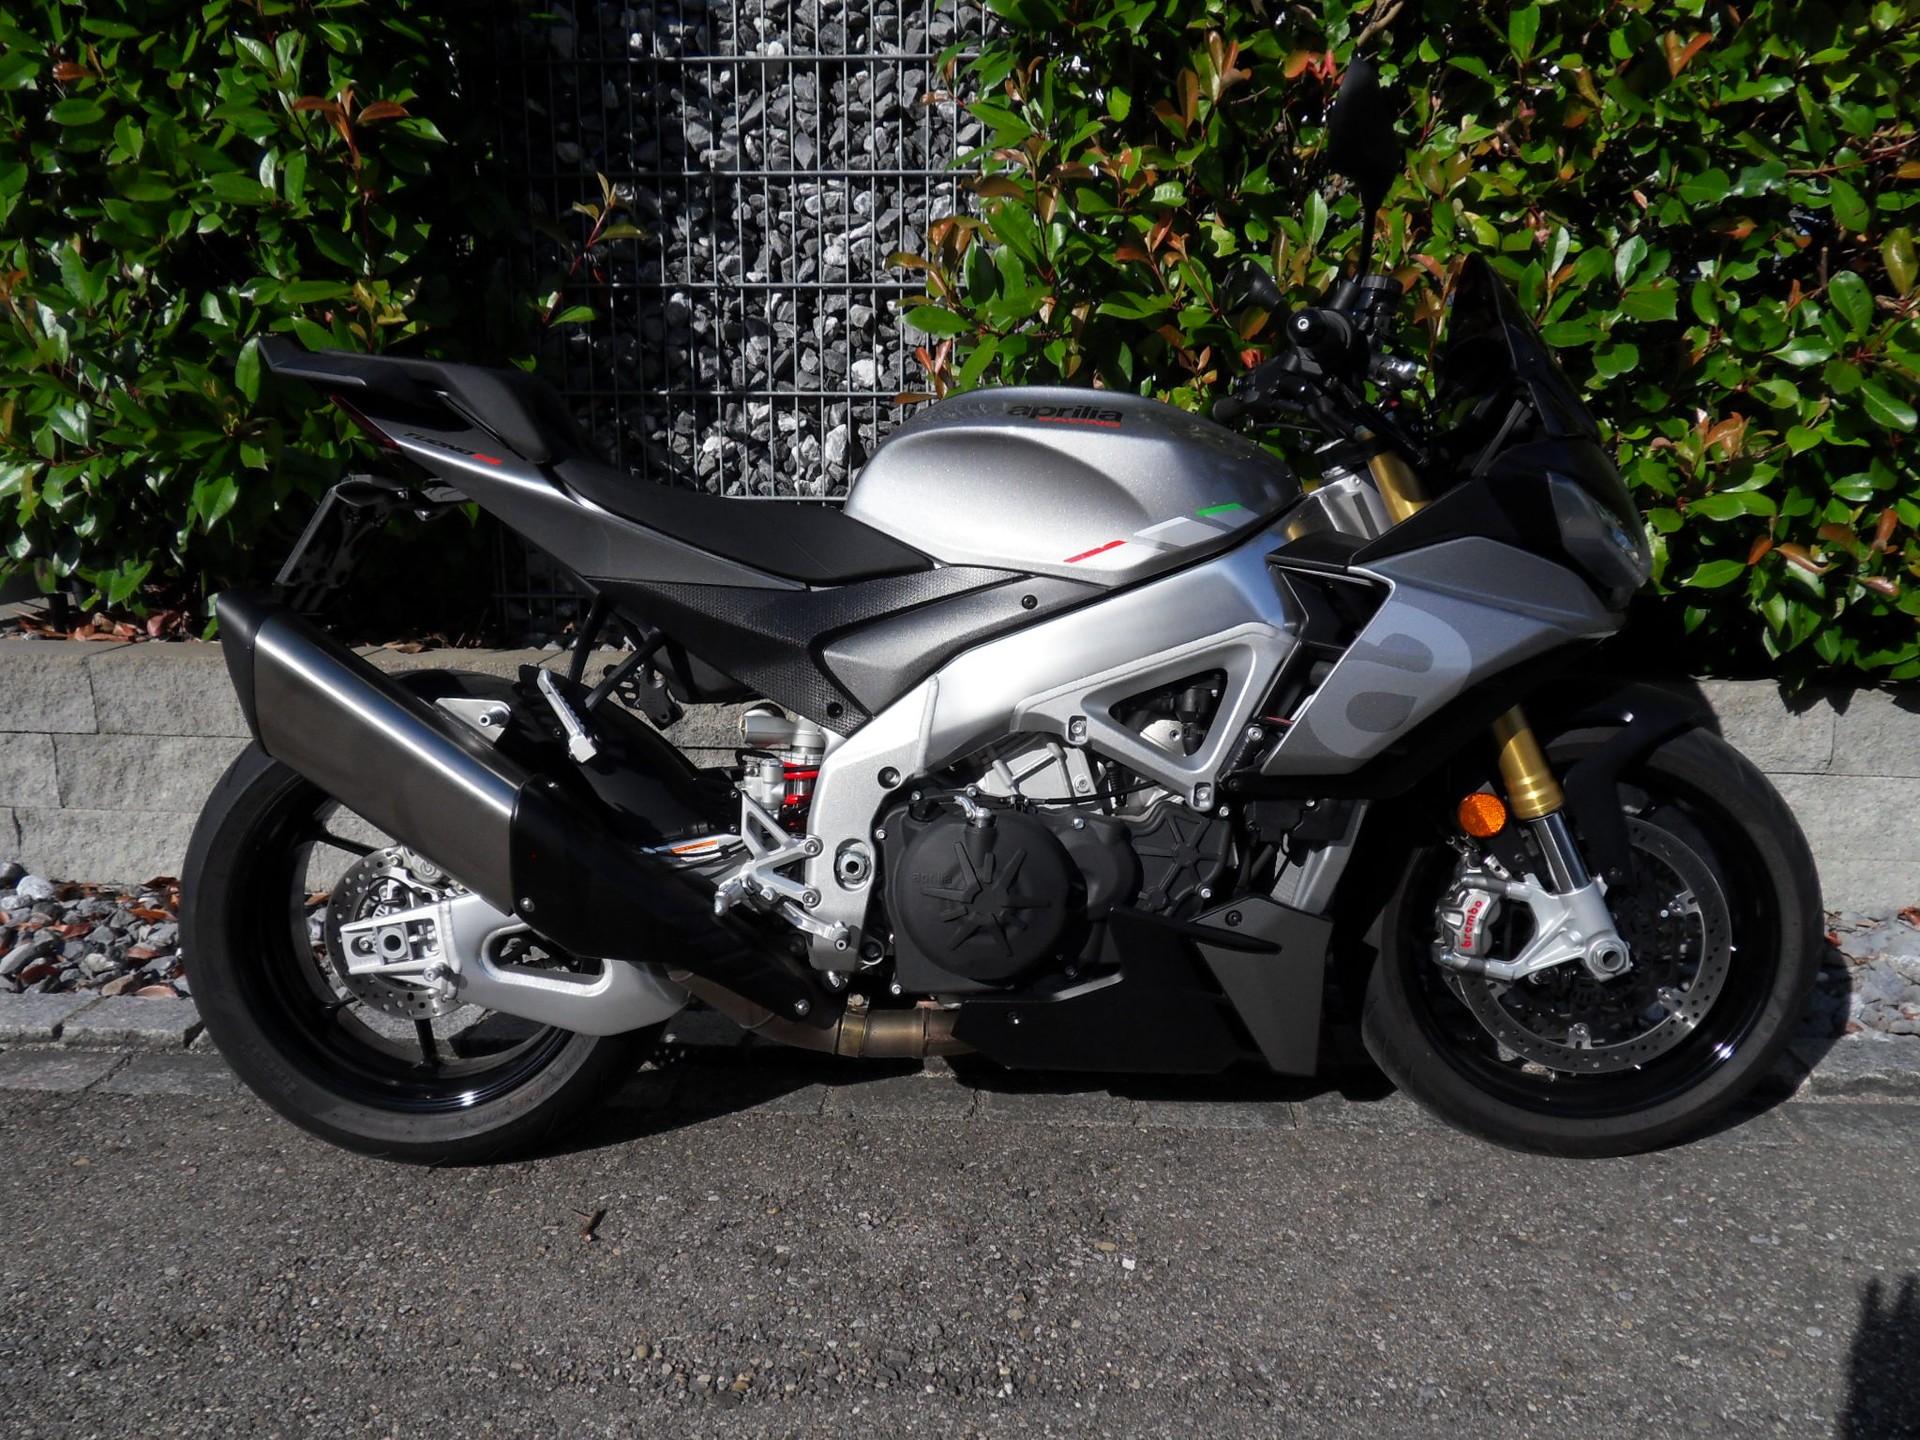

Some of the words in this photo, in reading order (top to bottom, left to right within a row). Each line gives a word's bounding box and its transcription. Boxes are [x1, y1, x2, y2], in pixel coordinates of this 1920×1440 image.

[1007, 404, 1123, 423] aprilia
[911, 871, 953, 887] aprilia
[1461, 900, 1482, 948] brembo
